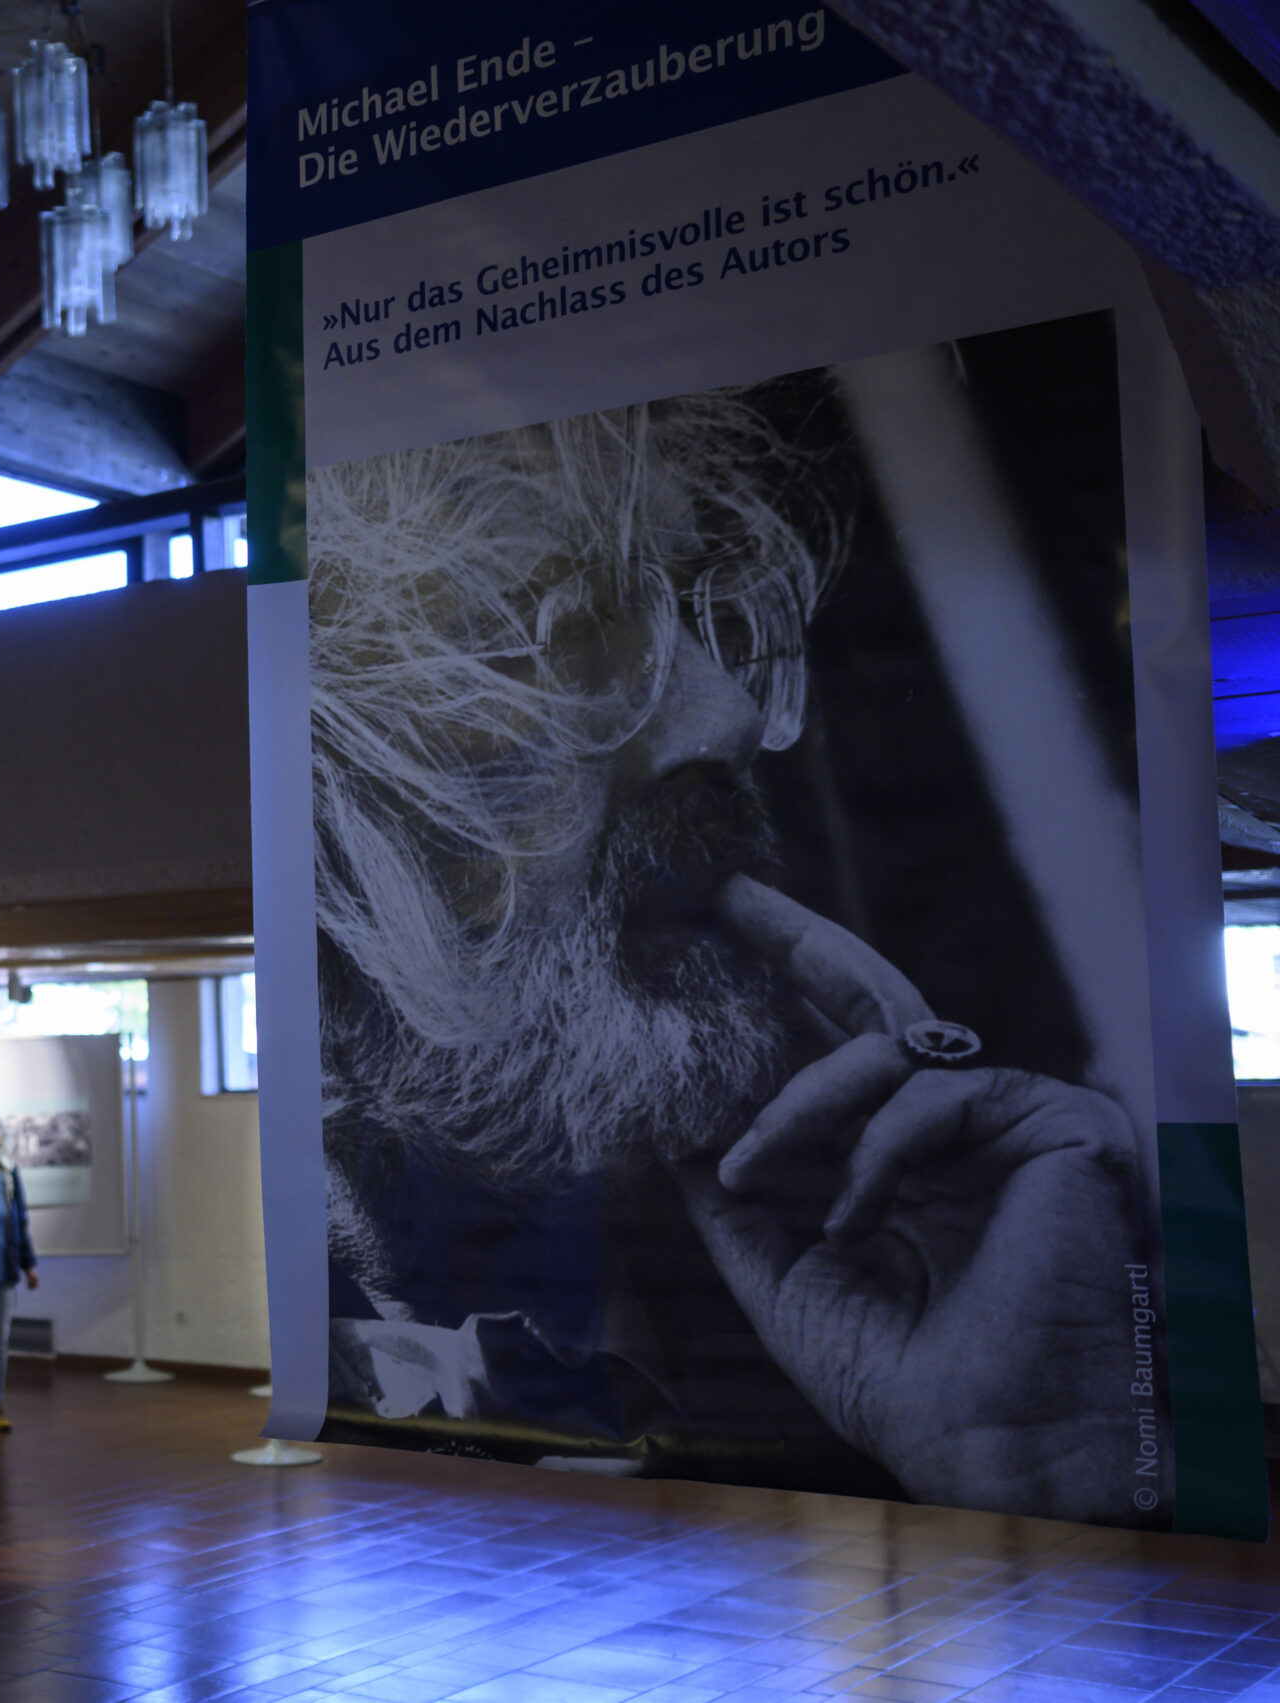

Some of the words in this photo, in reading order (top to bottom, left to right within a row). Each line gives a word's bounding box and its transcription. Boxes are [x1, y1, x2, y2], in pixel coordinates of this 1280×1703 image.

[297, 65, 439, 141] Michael
[455, 37, 556, 93] Ende
[298, 145, 359, 188] Die
[371, 9, 826, 165] Wiederverzauberung
[321, 295, 396, 331] »Nur
[406, 280, 464, 313] das
[475, 206, 746, 297] Geheimnisvolle
[761, 191, 809, 227] ist
[823, 153, 981, 213] schön.«
[322, 338, 382, 371] Aus
[392, 319, 462, 355] dem
[475, 280, 628, 337] Nachlass
[640, 262, 705, 297] des
[718, 227, 852, 281] Autors
[1123, 1263, 1157, 1397] Baumgartl
[1131, 1407, 1158, 1477] Nomi
